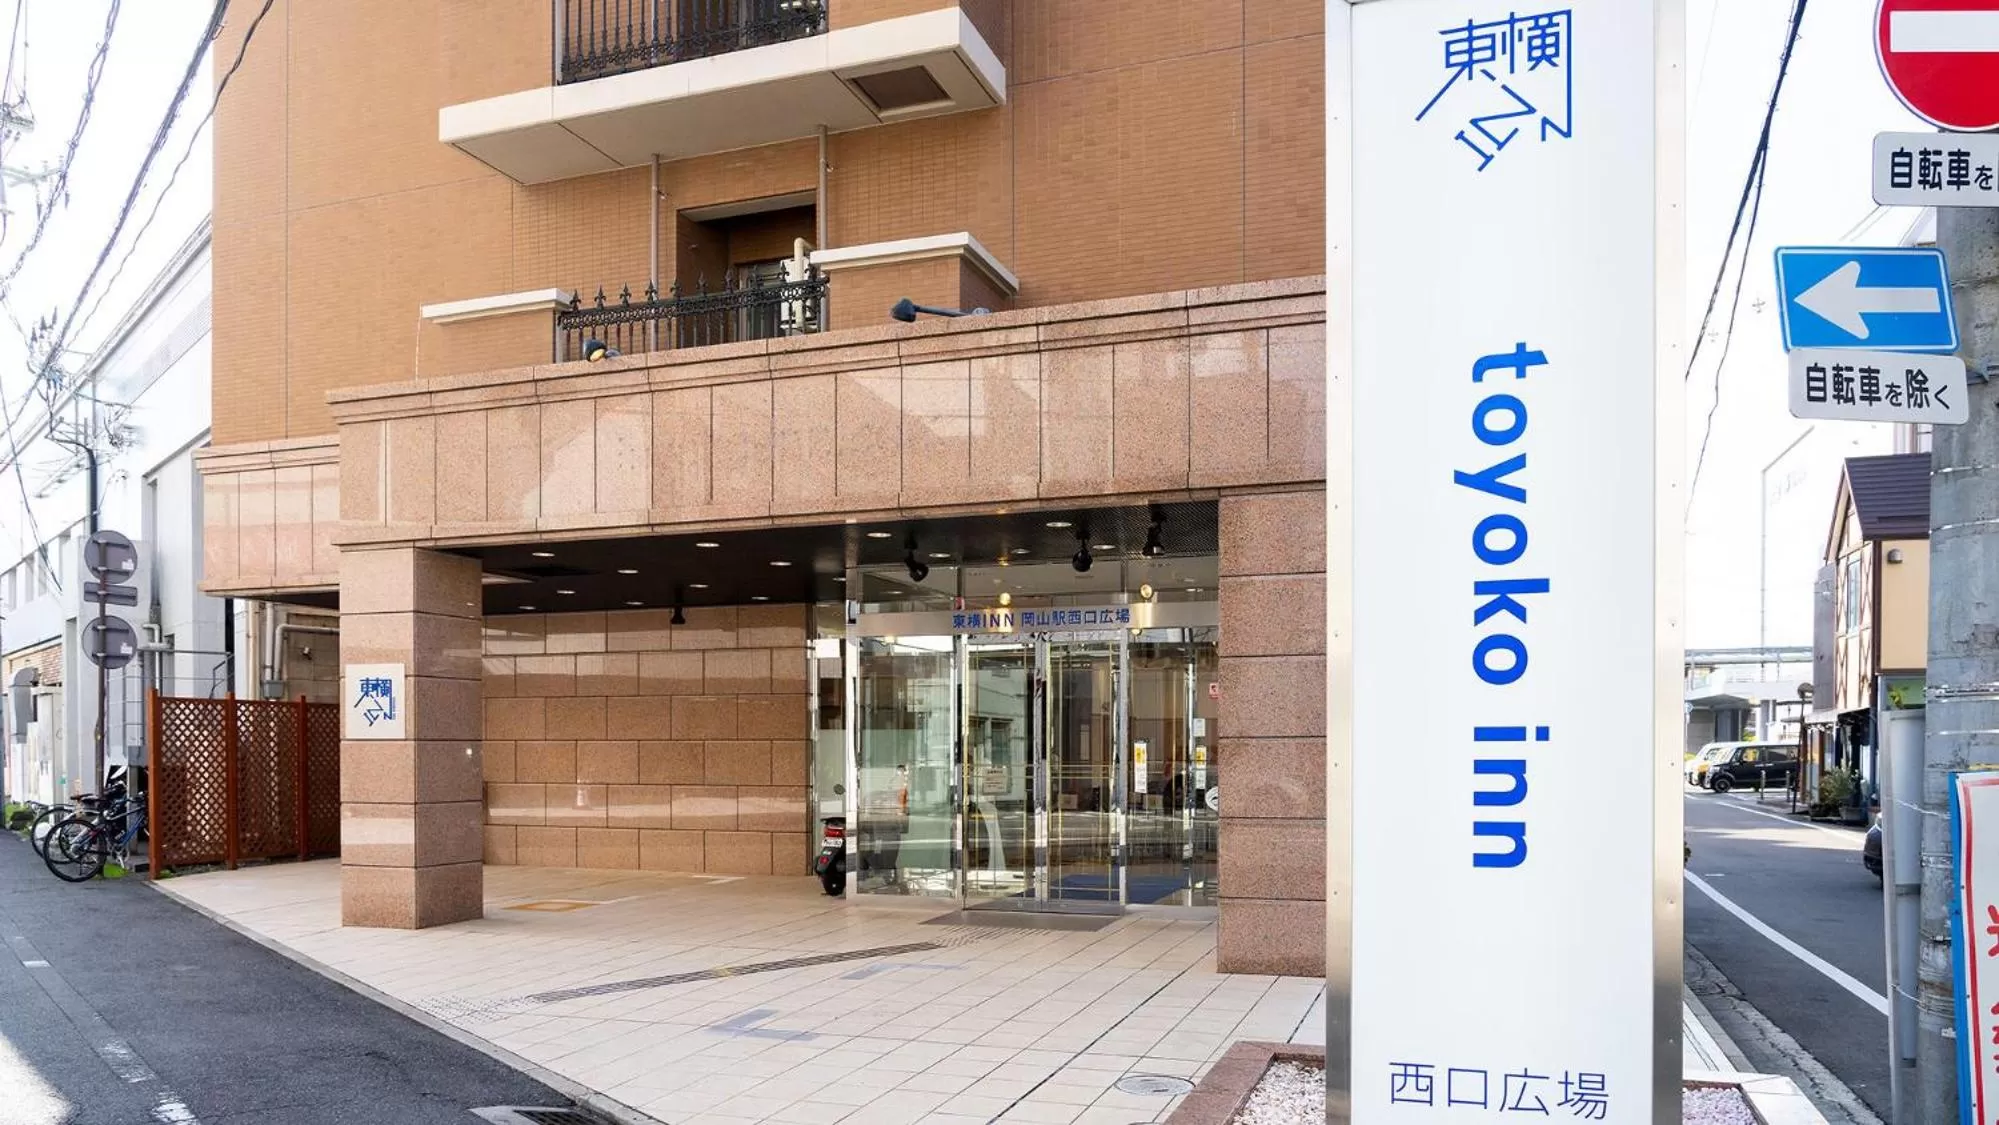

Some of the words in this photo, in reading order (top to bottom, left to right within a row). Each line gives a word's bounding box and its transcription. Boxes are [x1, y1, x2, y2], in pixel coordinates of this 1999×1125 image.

[1890, 147, 1999, 192] 自転車を
[1806, 363, 1951, 410] 自転車を除く
[1453, 341, 1551, 686] toyoko
[1021, 608, 1131, 628] 岡山駅西口広場
[1472, 725, 1551, 869] inn
[1389, 1062, 1609, 1120] 西口広場
